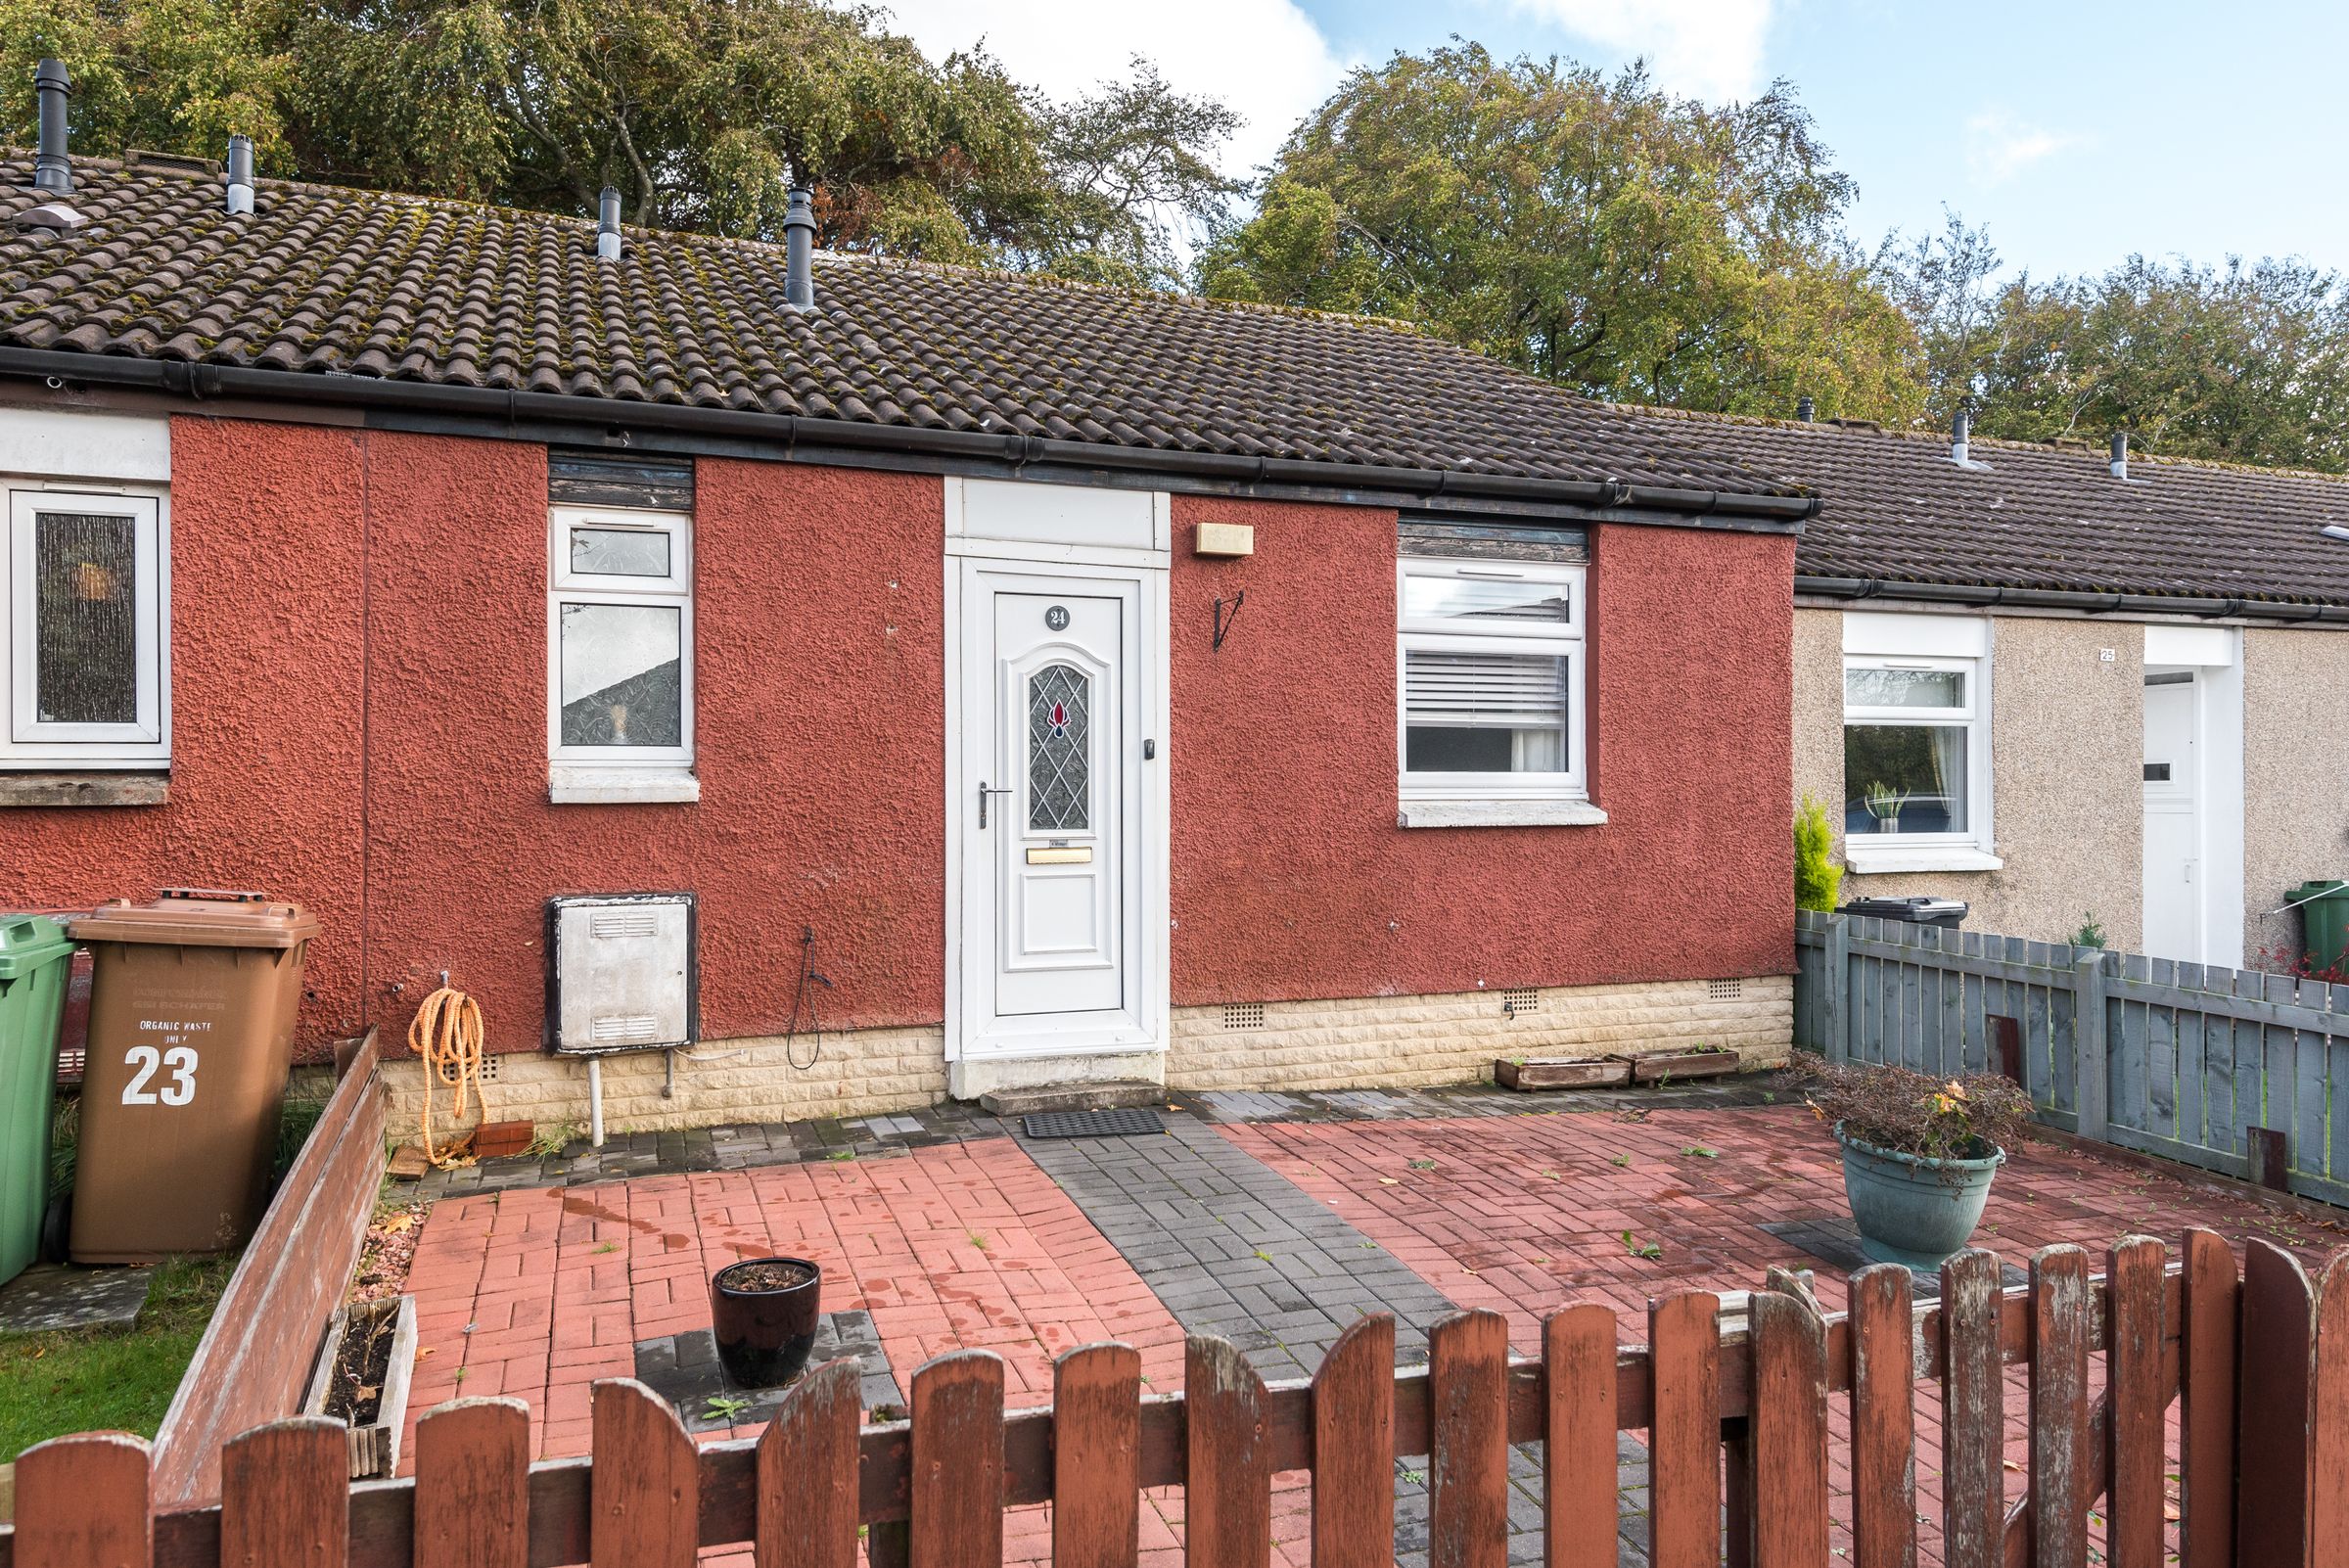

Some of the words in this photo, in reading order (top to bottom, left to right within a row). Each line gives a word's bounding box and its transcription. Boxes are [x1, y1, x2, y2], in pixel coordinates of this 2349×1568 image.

[1050, 611, 1066, 624] 24
[2101, 650, 2113, 660] 25
[140, 1020, 180, 1031] ORGANIC
[184, 1021, 211, 1032] WASTE
[121, 1045, 199, 1106] 23
